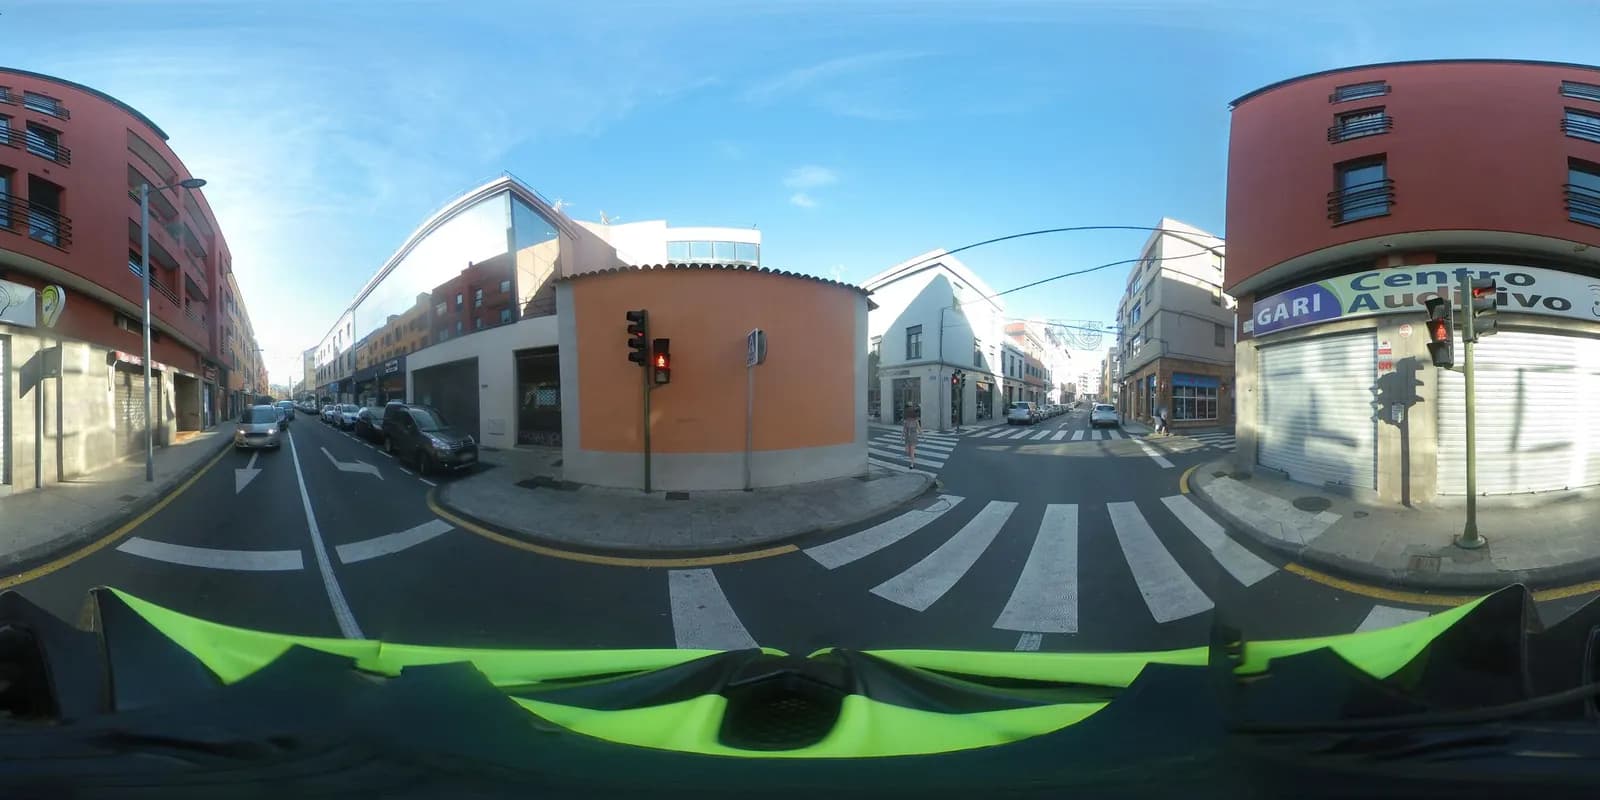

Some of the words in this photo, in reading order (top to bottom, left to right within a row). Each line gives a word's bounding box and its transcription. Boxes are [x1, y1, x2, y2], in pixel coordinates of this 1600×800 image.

[1350, 267, 1536, 291] Centro
[1257, 293, 1321, 326] GARI
[1348, 286, 1572, 314] Audiivo
